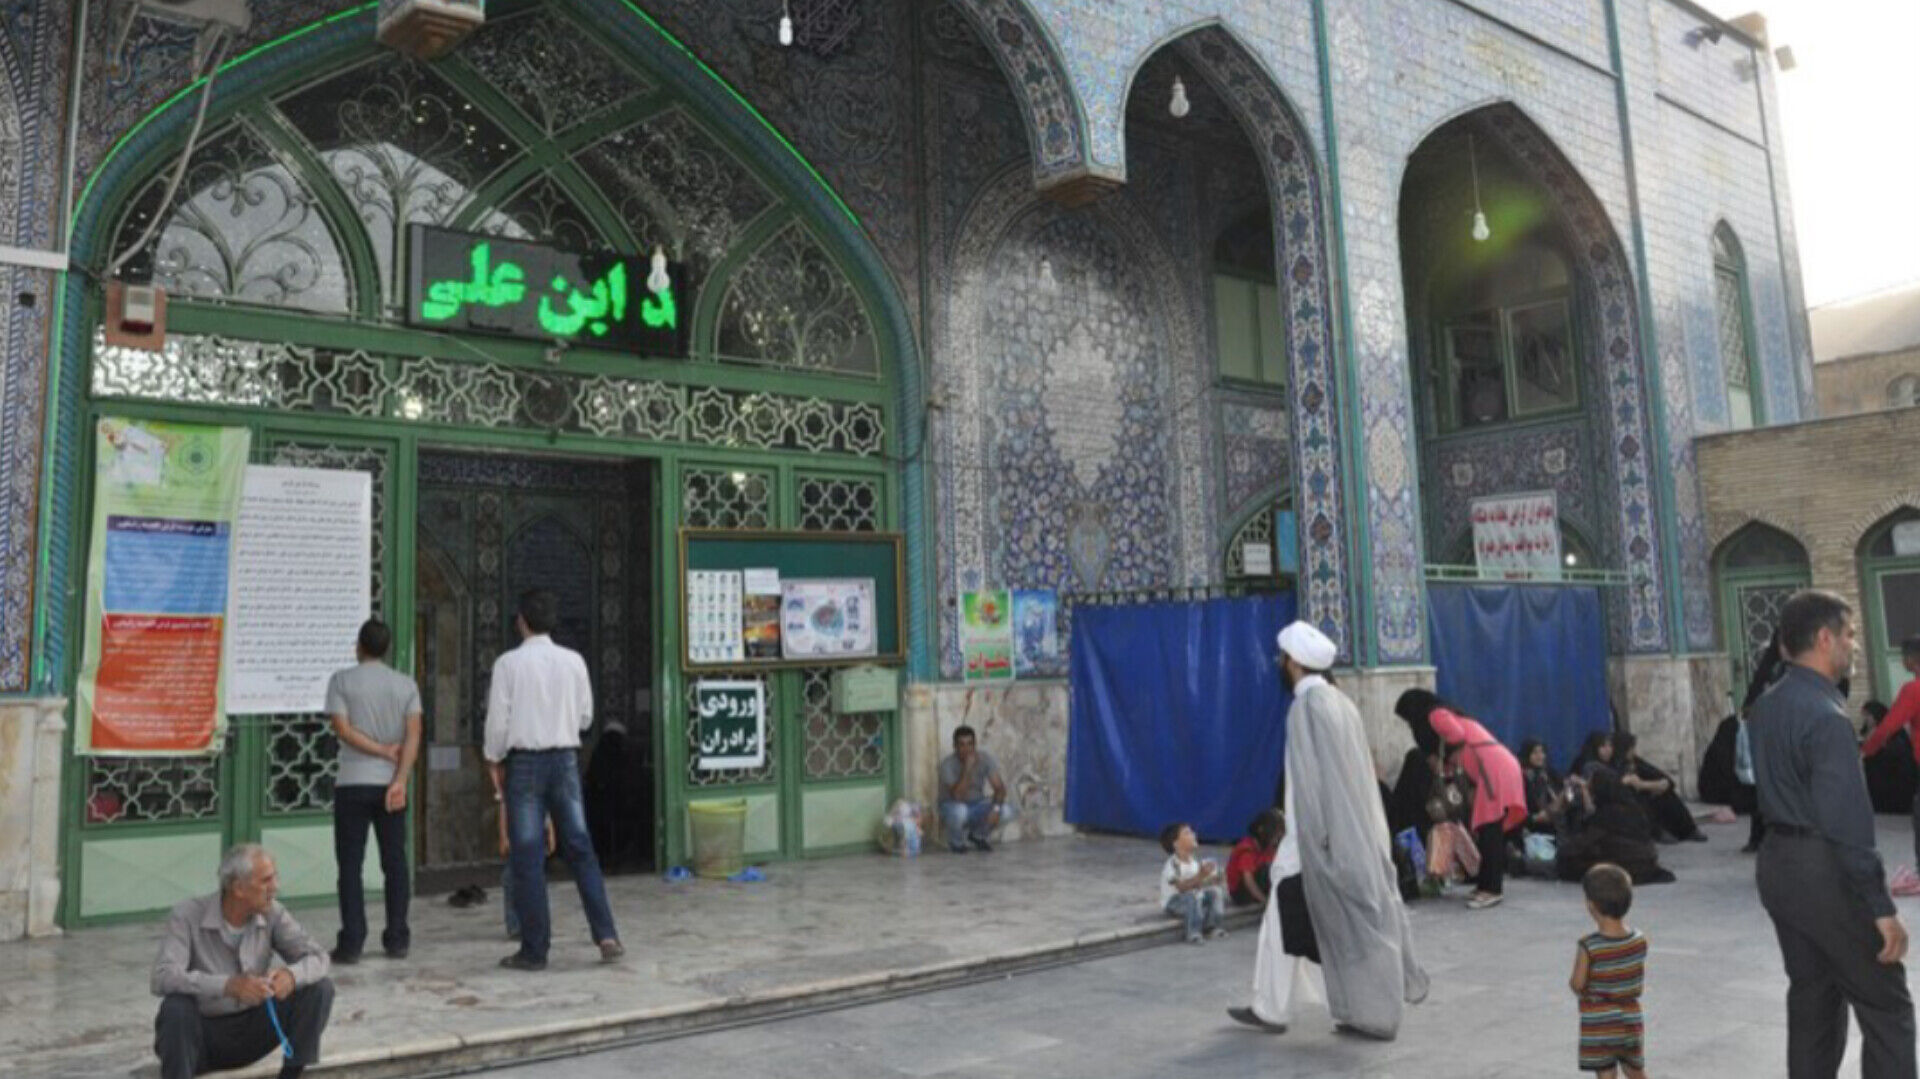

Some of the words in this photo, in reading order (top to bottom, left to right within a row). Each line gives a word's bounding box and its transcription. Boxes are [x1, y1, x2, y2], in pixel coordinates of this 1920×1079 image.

[422, 240, 526, 320] علی
[538, 261, 627, 335] ابن
[700, 692, 756, 717] ورودی
[701, 728, 757, 754] برادران
